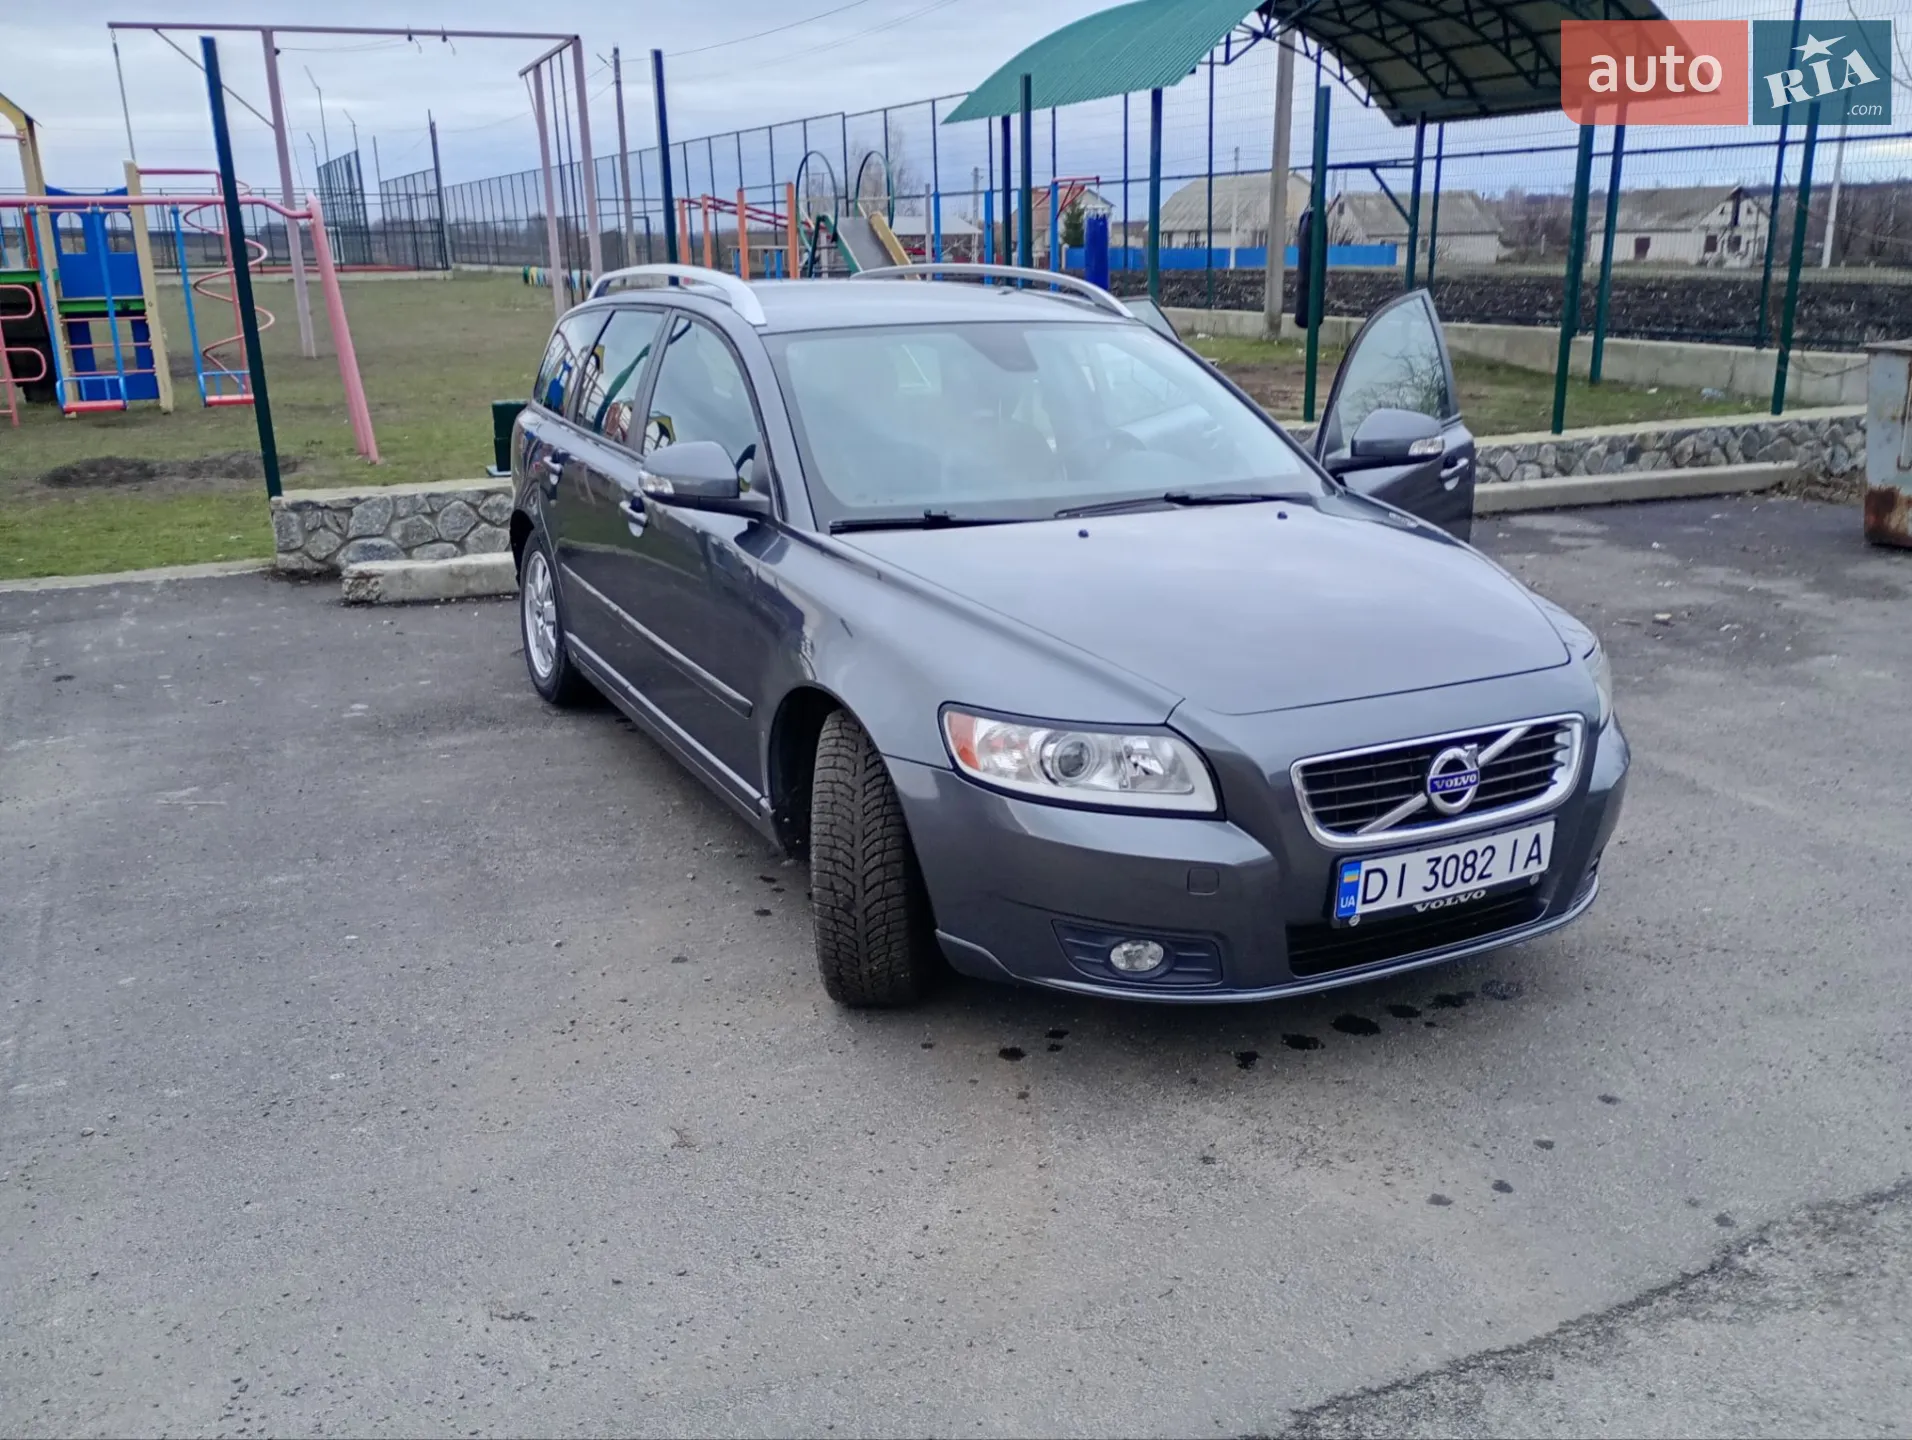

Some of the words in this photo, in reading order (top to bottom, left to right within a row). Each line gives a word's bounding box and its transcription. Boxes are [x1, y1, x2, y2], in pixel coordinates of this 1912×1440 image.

[1433, 773, 1477, 790] VOLVO
[1361, 863, 1406, 905] DI
[1422, 845, 1496, 893] 3082
[1508, 833, 1542, 873] IA
[1340, 896, 1356, 909] UA
[1413, 889, 1487, 913] VOLVO
